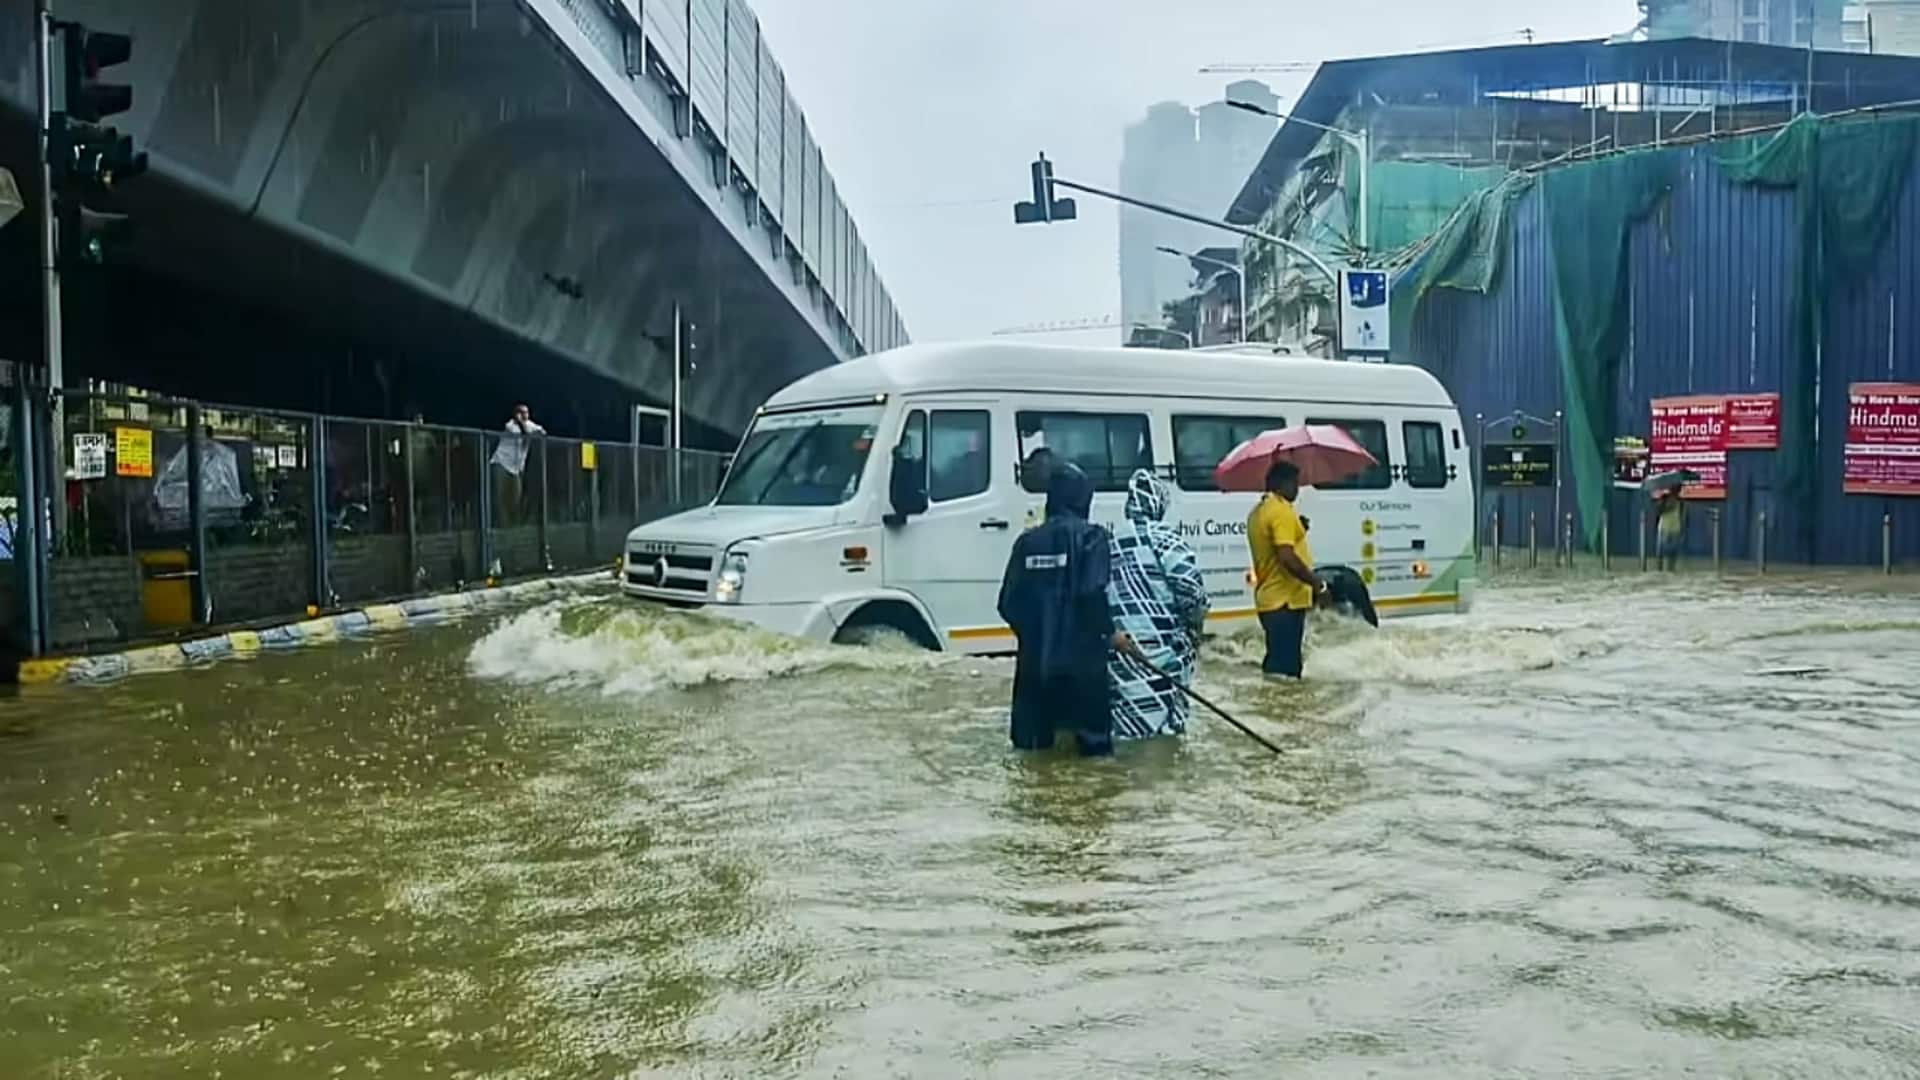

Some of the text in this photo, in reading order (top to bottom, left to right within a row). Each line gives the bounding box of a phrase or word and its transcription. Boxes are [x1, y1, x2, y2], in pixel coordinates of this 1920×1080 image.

[1850, 406, 1918, 426] Hindma
[1178, 519, 1247, 536] hvi Cance
